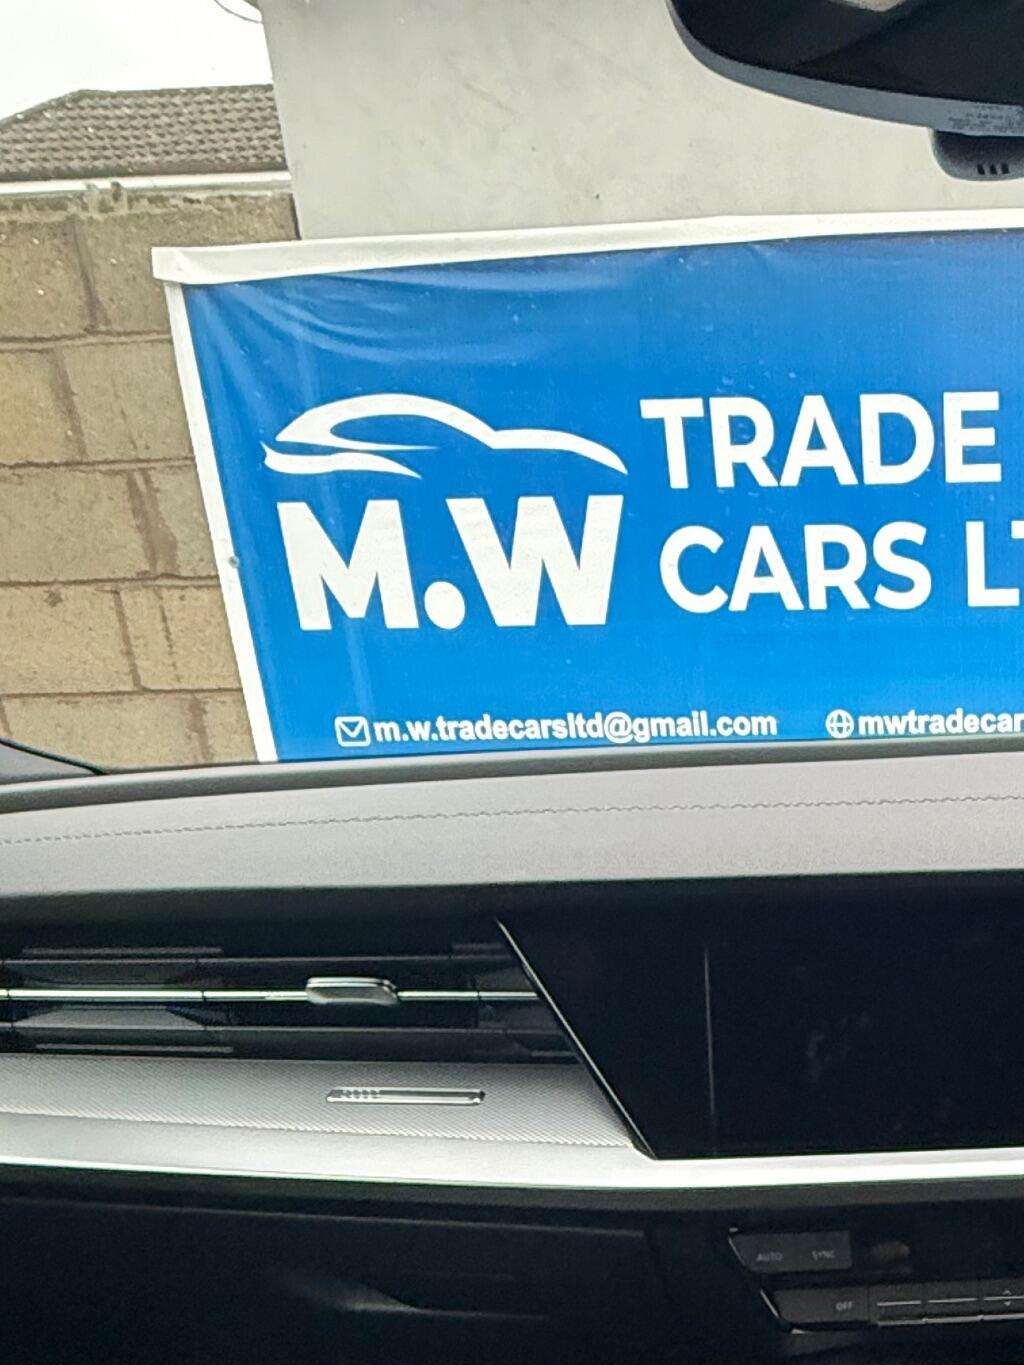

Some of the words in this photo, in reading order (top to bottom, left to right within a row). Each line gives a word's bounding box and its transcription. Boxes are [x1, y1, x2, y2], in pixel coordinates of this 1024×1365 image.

[639, 390, 1002, 490] TRADE
[276, 494, 624, 631] M.W
[659, 521, 933, 614] CARS
[373, 710, 779, 745] m.w.tradecarsltd@gmail.com
